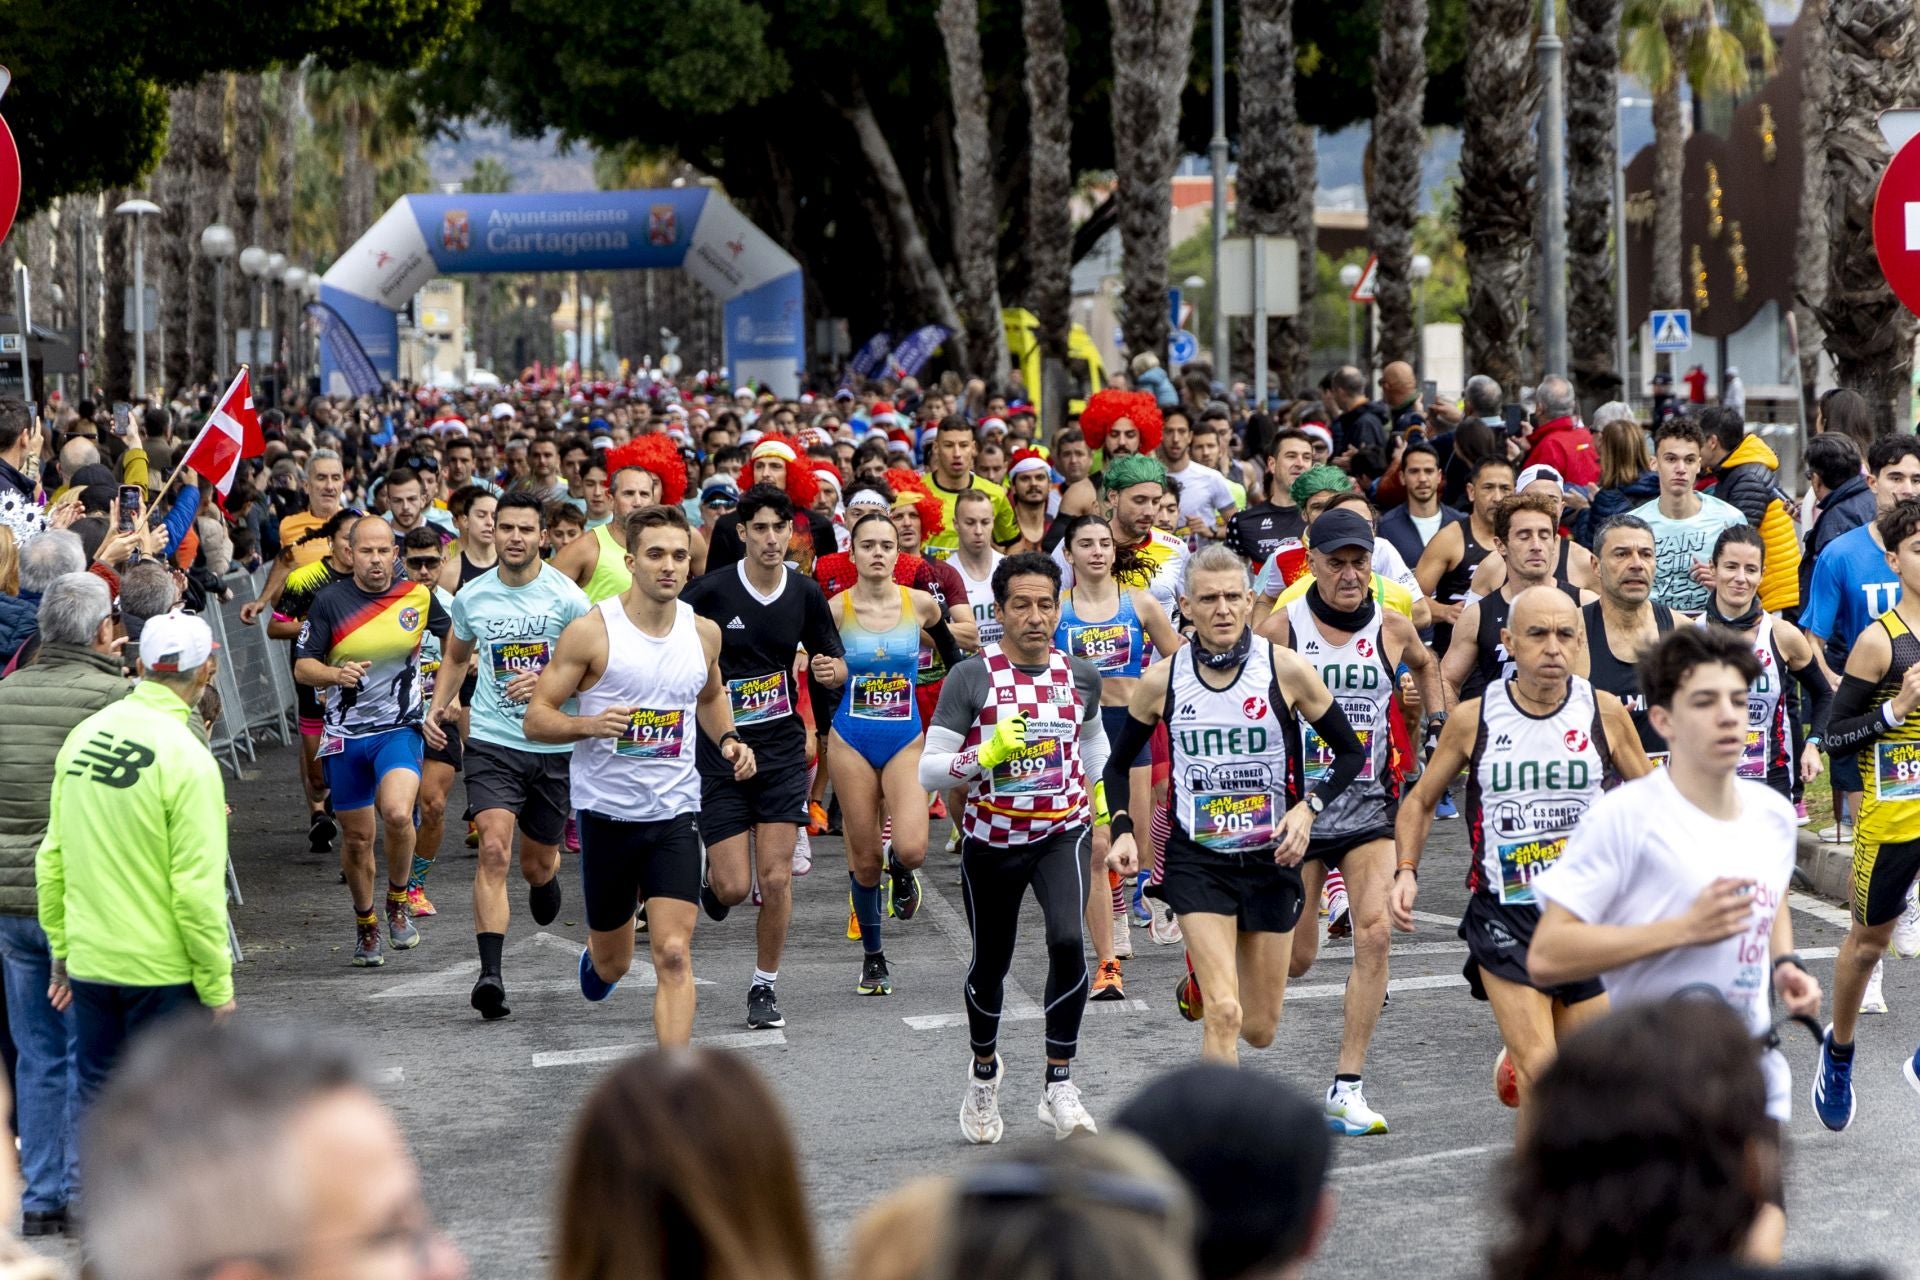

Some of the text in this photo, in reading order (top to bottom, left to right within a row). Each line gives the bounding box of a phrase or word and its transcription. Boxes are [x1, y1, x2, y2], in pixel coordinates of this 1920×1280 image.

[487, 207, 629, 227] Ayuntamiento
[487, 227, 628, 256] Cartagena
[1085, 638, 1117, 657] 835
[502, 656, 541, 671] 1034
[743, 679, 761, 689] SAN
[743, 674, 782, 695] SILVESTRE
[866, 679, 884, 687] SAN
[1313, 664, 1379, 690] NED
[741, 688, 780, 710] 2179
[864, 691, 901, 705] 1591
[634, 710, 656, 718] SAN
[1344, 704, 1371, 712] CABEZO
[633, 711, 681, 726] SILVESTRE
[631, 724, 675, 744] 1914
[1180, 727, 1267, 757] UNED
[1842, 725, 1872, 744] TRAIL
[1006, 738, 1057, 762] SILVESTRE
[1894, 744, 1914, 754] SAN
[1010, 757, 1046, 778] 899
[1233, 767, 1264, 779] CABEZO
[1492, 759, 1589, 792] UNED
[1220, 778, 1265, 790] VENTURA
[1210, 795, 1265, 817] SILVESTRE
[1211, 796, 1233, 808] SAN
[1213, 813, 1254, 835] 905
[1516, 842, 1540, 856] SAN
